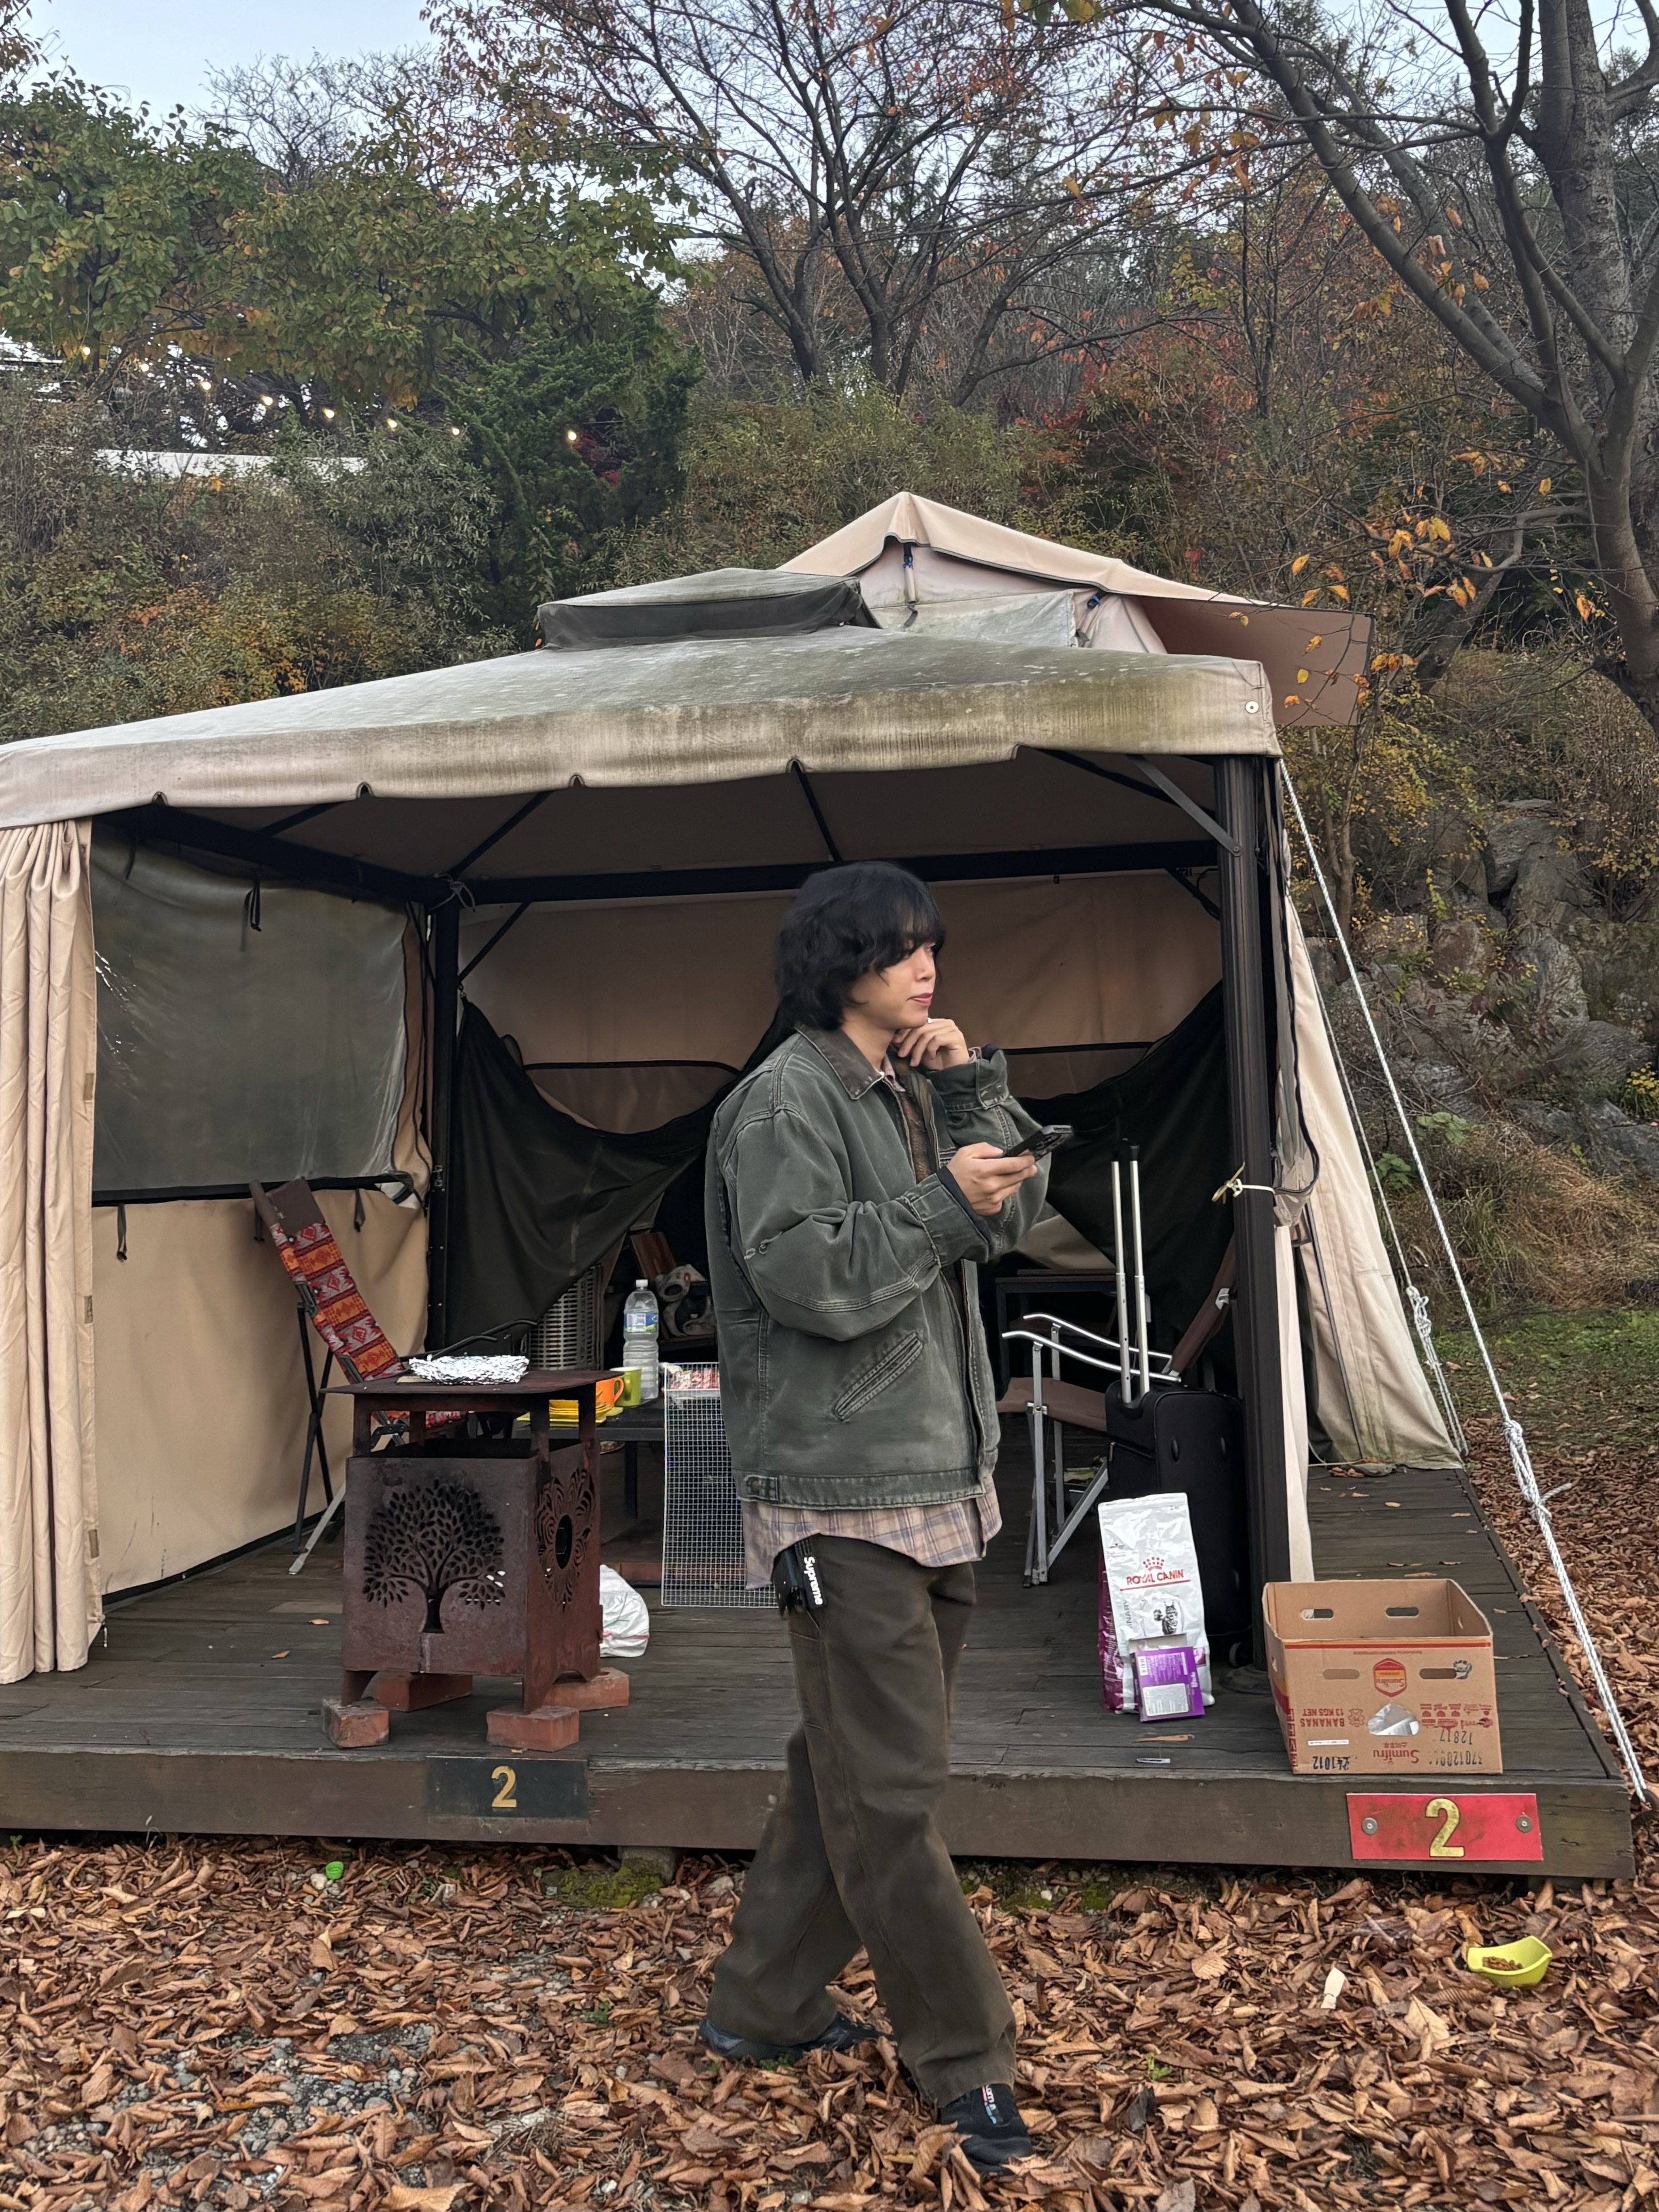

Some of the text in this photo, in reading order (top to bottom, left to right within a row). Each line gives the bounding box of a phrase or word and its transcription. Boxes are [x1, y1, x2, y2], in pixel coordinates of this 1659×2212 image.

[804, 1556, 823, 1605] Supreme
[1126, 1569, 1184, 1586] ROYAL CANIN
[1300, 1718, 1345, 1727] BANANAS
[1373, 1749, 1420, 1764] Sumifru
[491, 1765, 517, 1807] 2
[1425, 1798, 1465, 1857] 2
